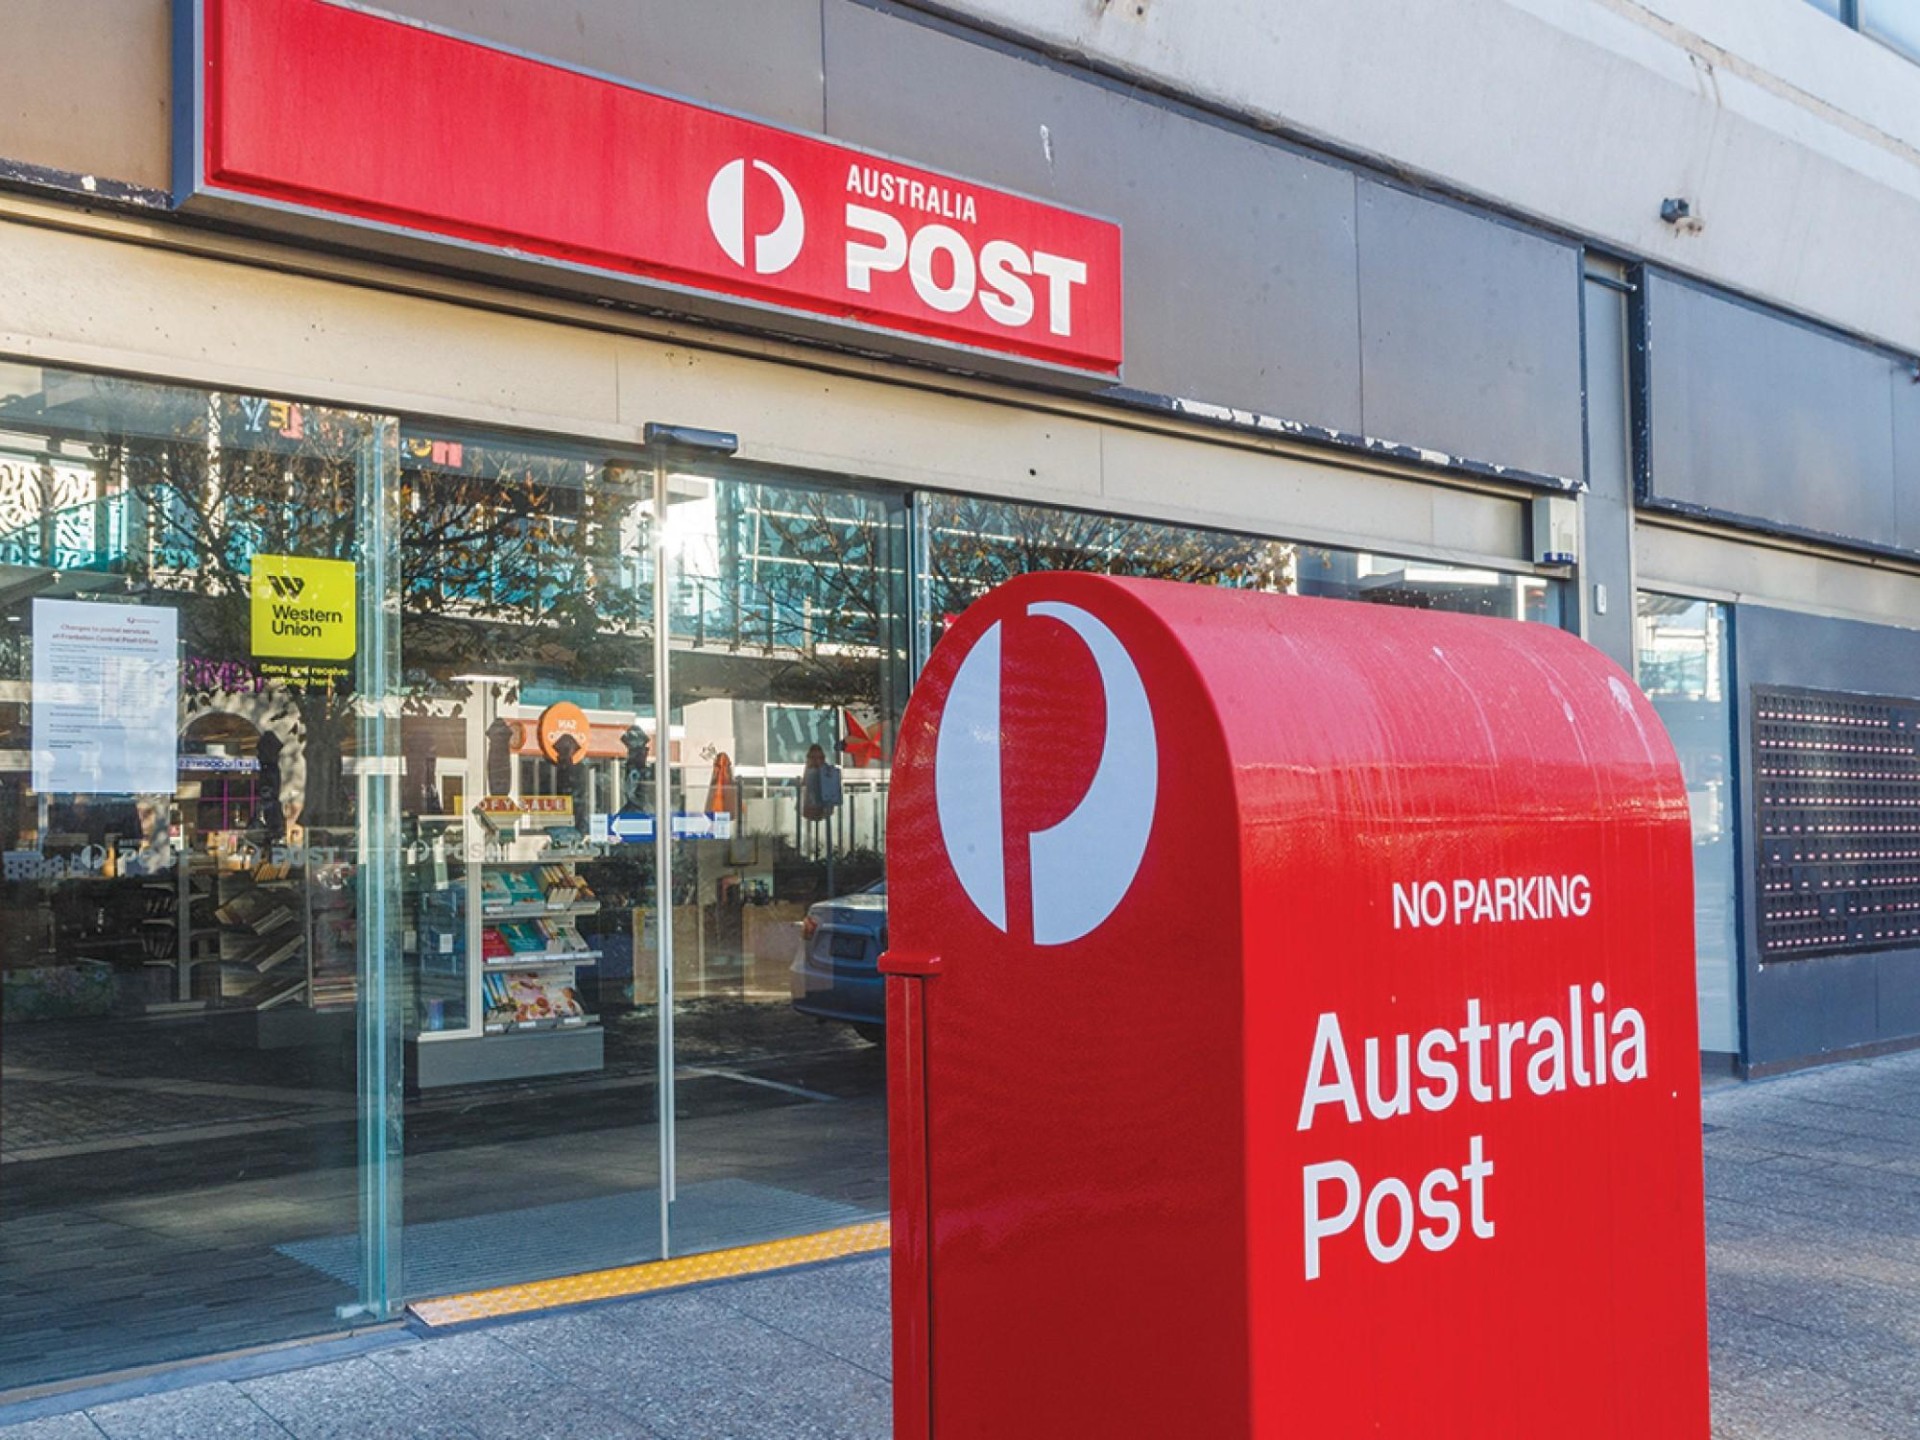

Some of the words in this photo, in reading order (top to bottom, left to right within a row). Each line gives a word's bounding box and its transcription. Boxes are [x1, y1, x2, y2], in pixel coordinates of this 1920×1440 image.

[847, 164, 977, 224] AUSTRALIA
[846, 203, 1087, 336] POST
[272, 604, 343, 623] Western
[272, 620, 322, 637] Union
[261, 663, 288, 674] Send
[1392, 881, 1447, 929] NO
[1453, 874, 1592, 924] PARKING
[1297, 982, 1648, 1131] Australia
[1303, 1136, 1495, 1281] Post
